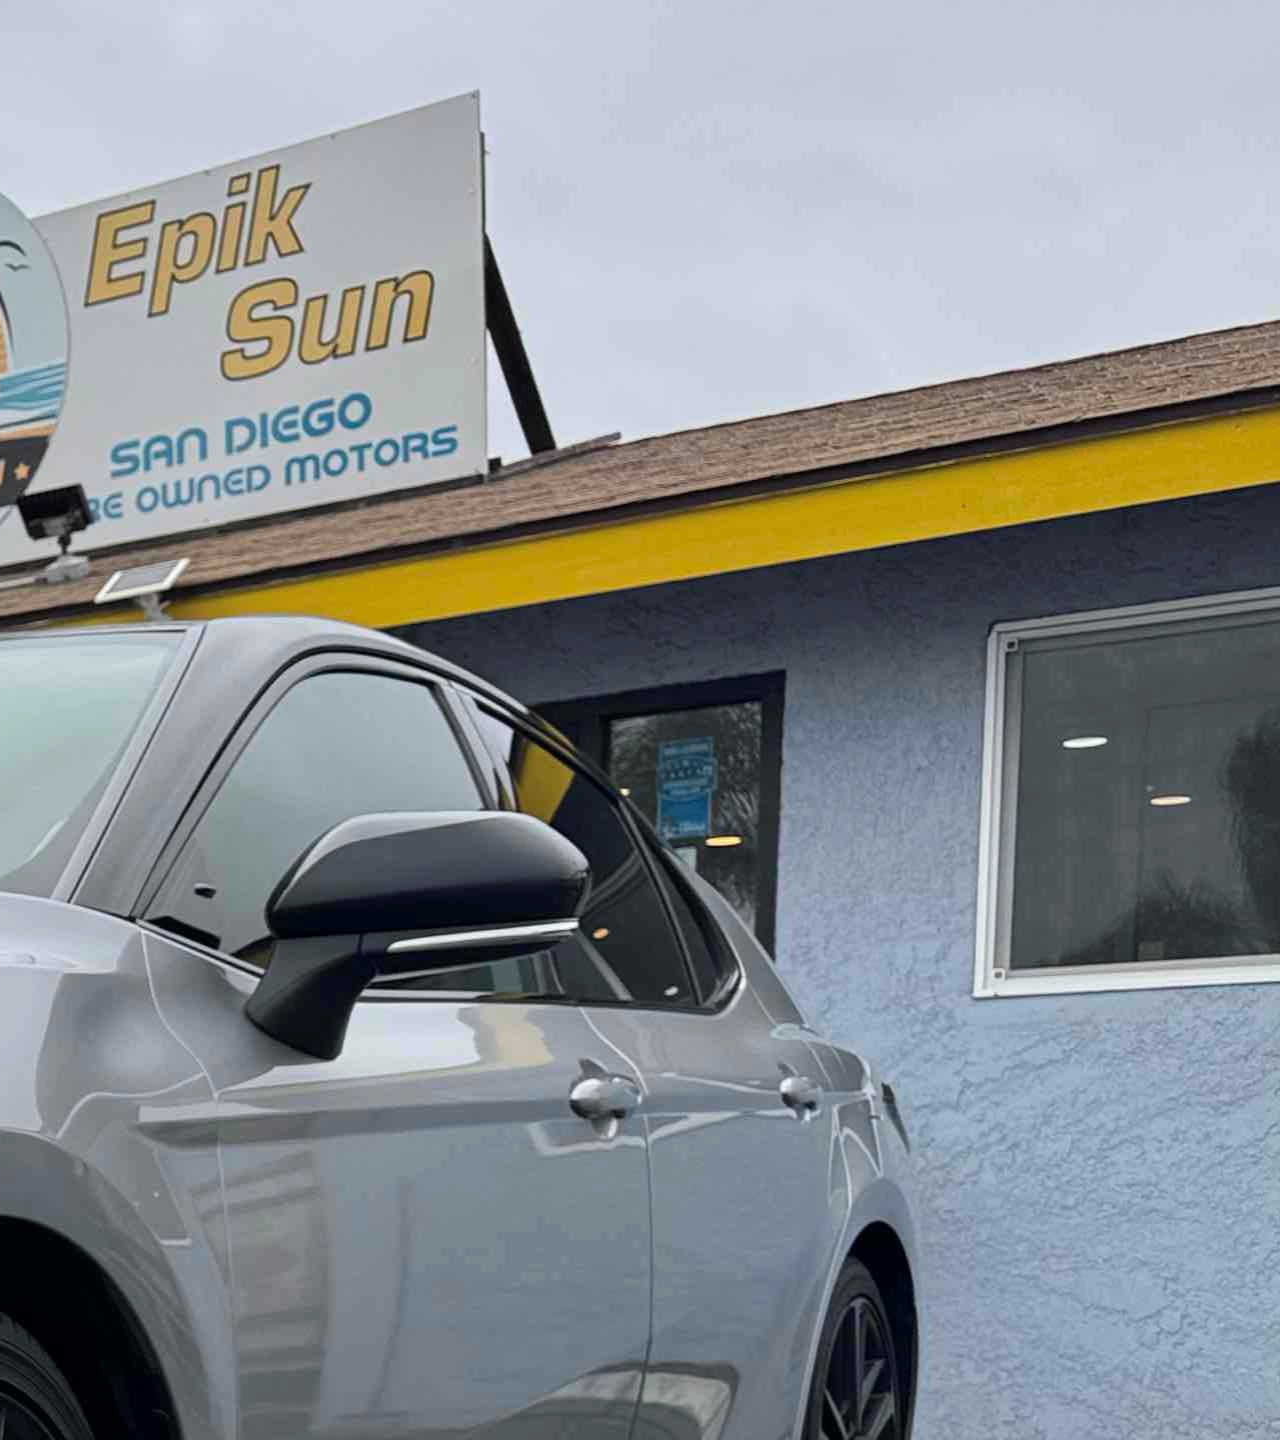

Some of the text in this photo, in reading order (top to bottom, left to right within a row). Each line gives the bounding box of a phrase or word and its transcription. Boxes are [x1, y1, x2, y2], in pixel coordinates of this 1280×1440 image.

[84, 163, 312, 318] Epik
[220, 269, 435, 381] Sun
[110, 392, 372, 478] SAN DIEGO
[136, 464, 271, 513] OWNED
[284, 425, 458, 486] MOTORS
